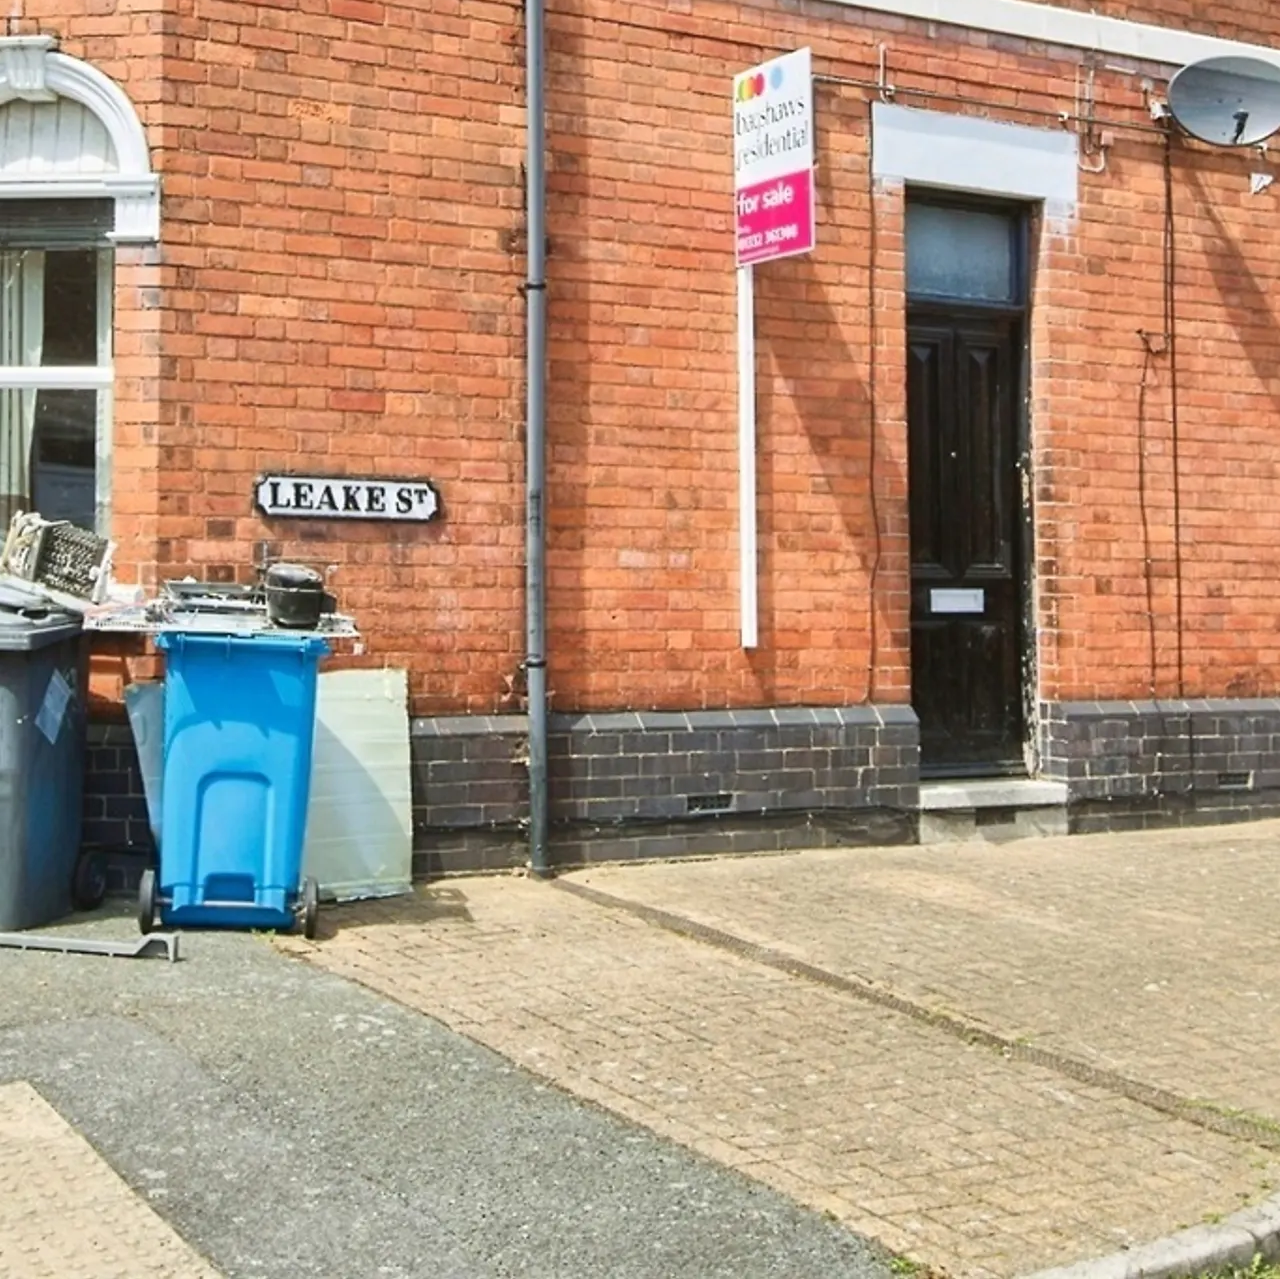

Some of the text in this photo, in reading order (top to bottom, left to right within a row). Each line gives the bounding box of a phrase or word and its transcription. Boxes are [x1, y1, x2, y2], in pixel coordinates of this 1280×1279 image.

[736, 119, 808, 171] residential
[737, 181, 795, 217] for sale
[268, 482, 386, 512] LEAKE
